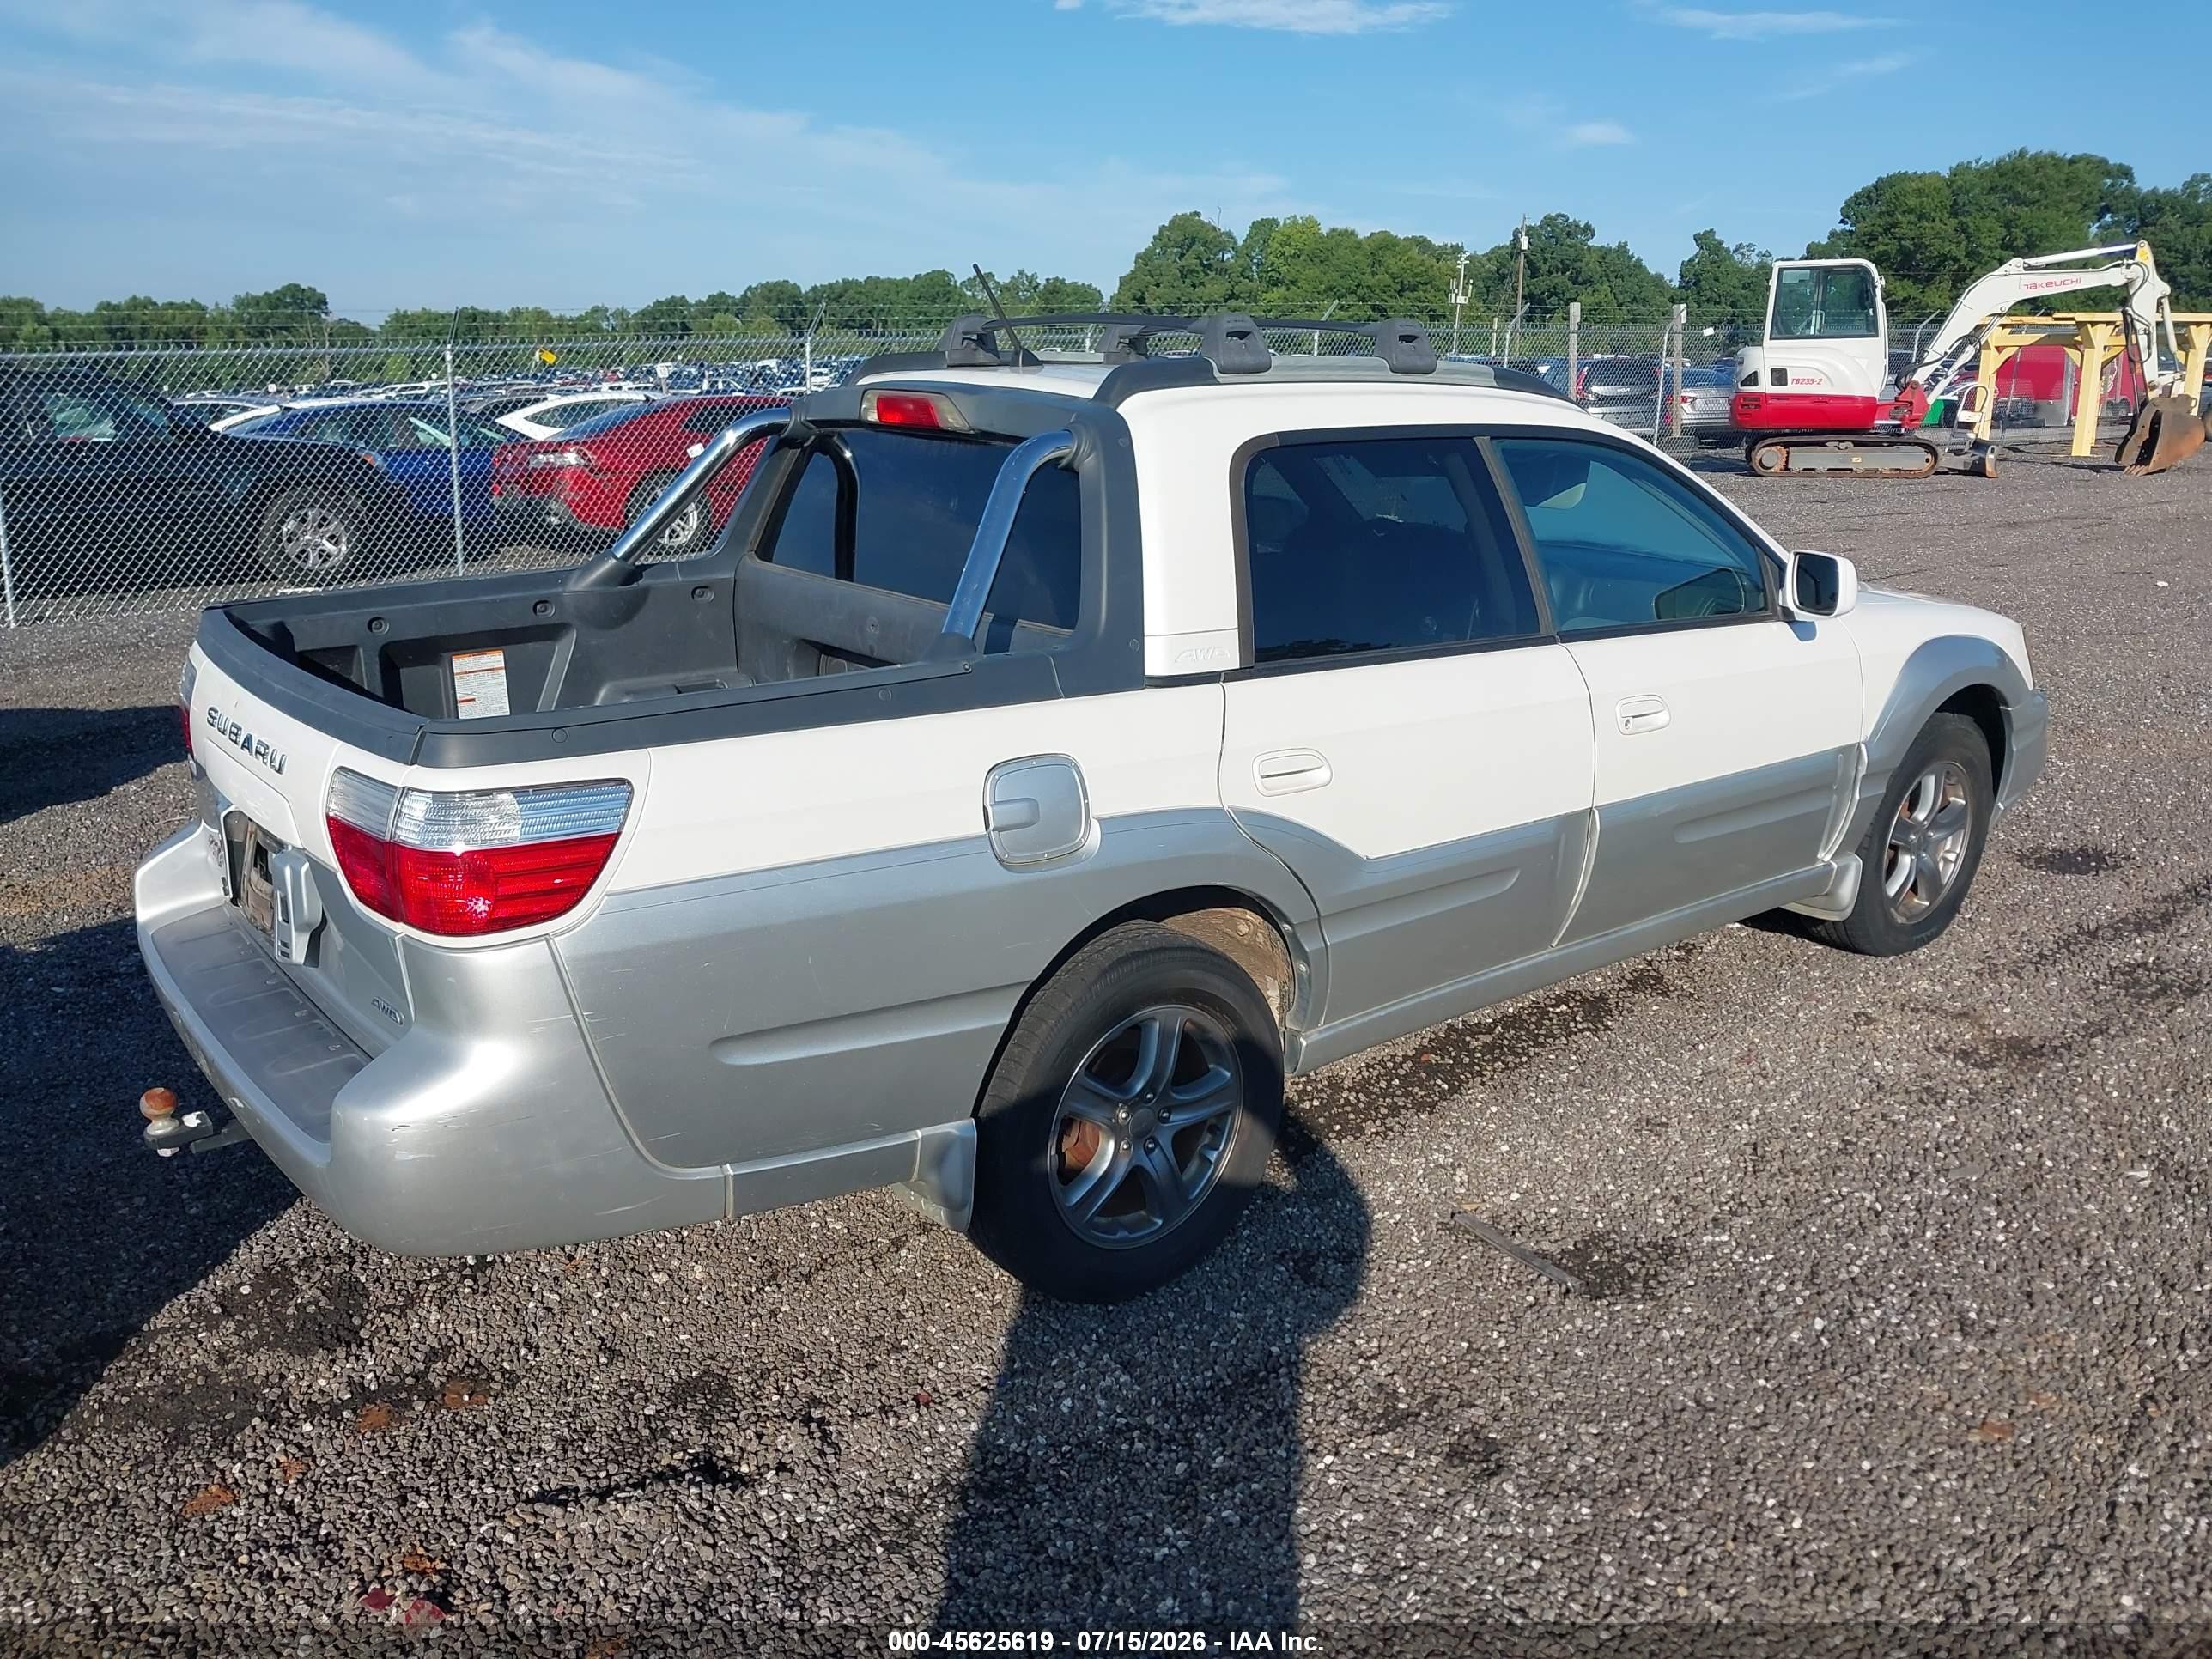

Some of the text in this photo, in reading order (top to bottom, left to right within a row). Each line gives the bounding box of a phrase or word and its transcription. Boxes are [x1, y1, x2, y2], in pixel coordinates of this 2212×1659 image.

[1790, 377, 1823, 386] TB235-2
[206, 706, 288, 775] SUBARU
[371, 996, 404, 1025] AWD
